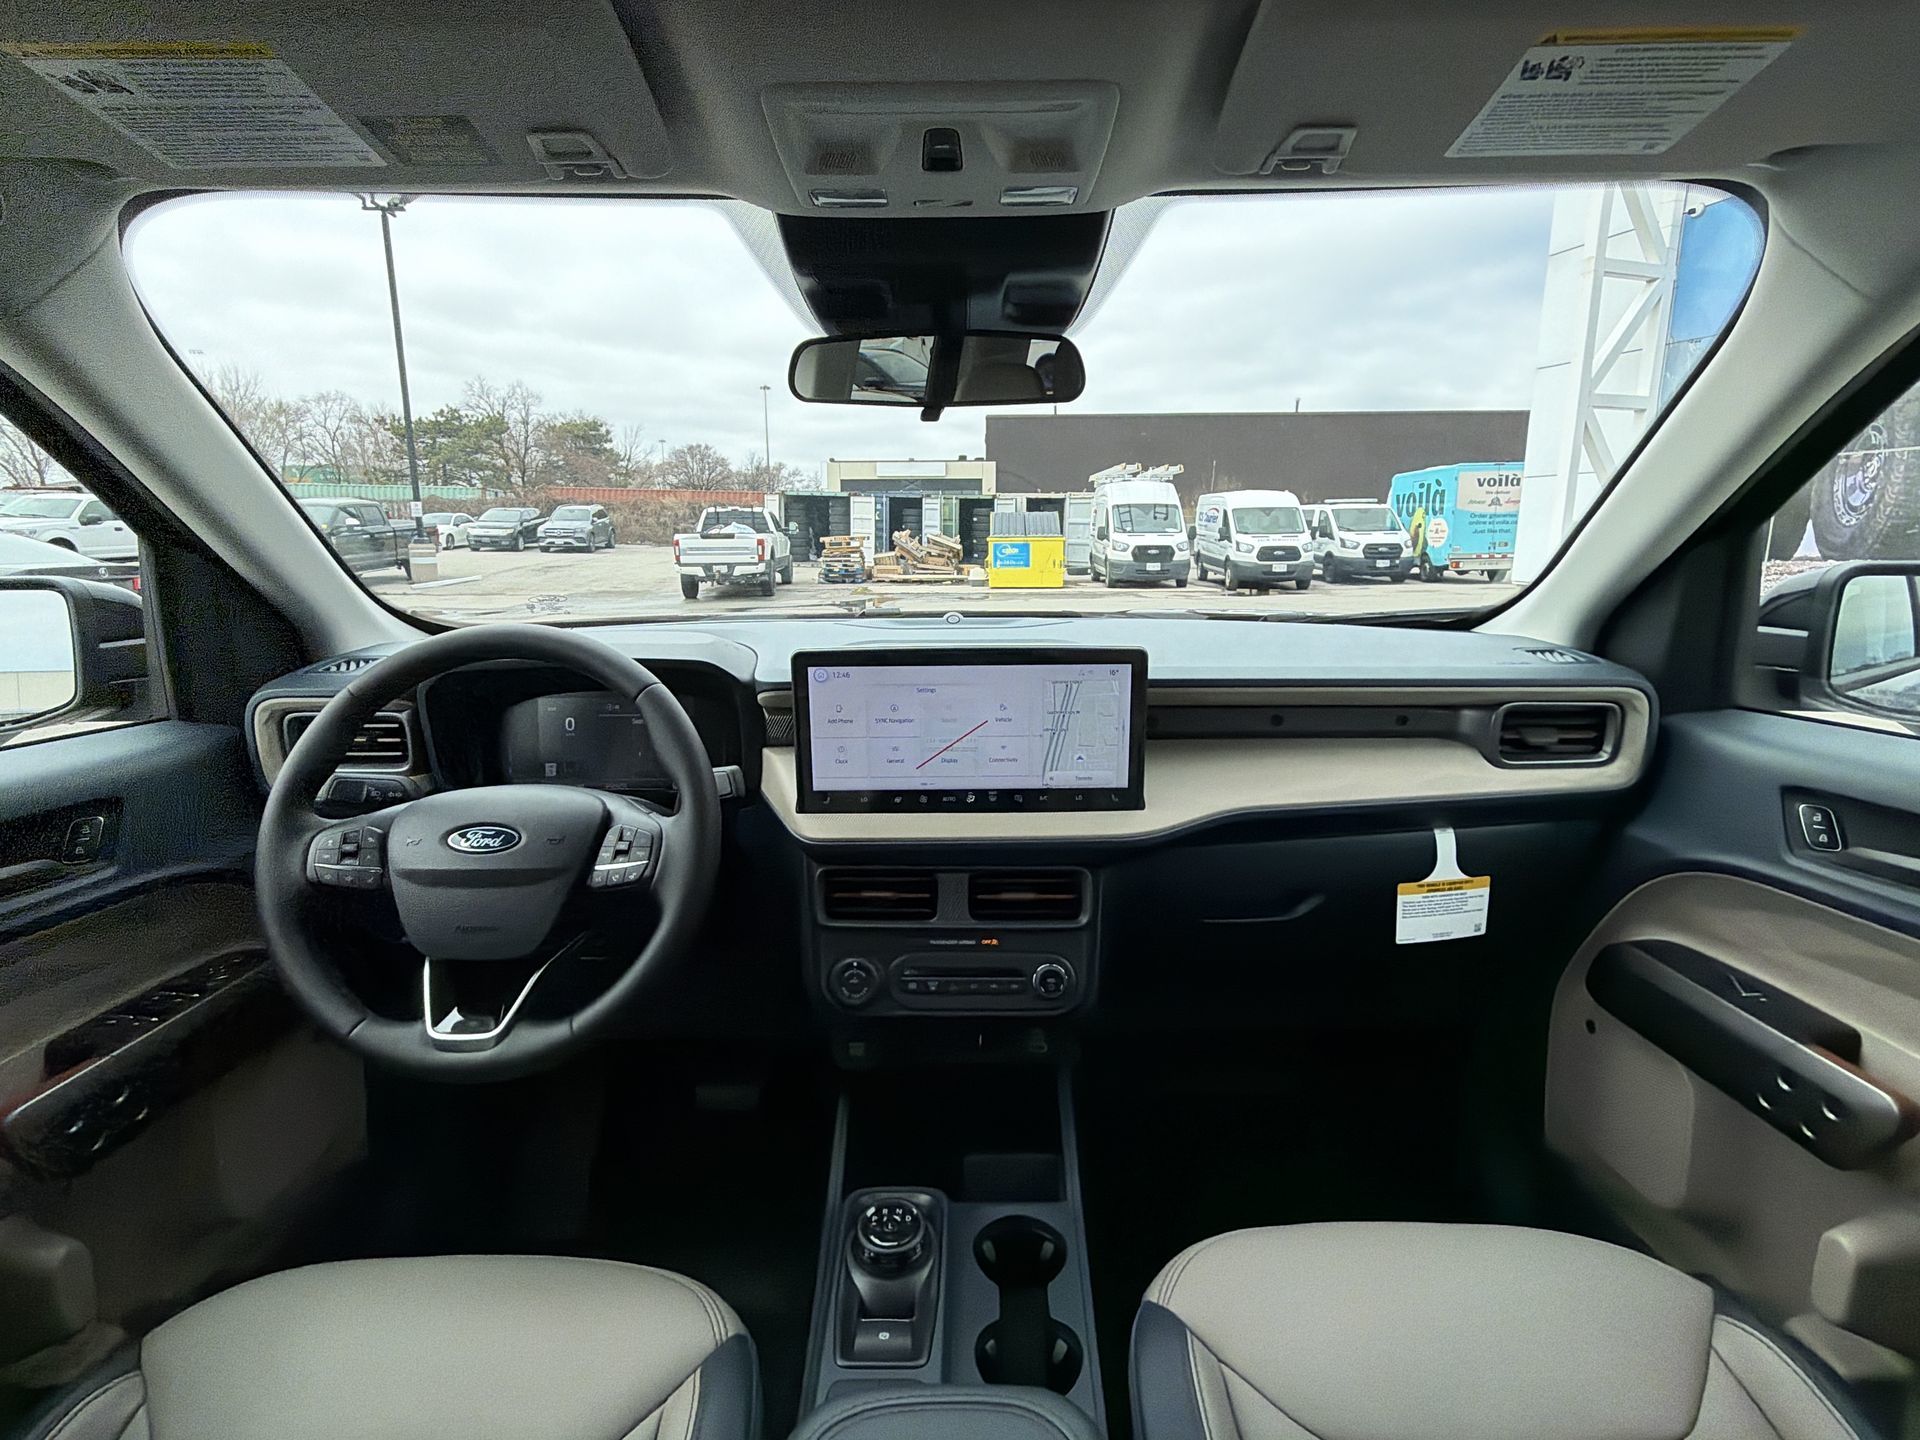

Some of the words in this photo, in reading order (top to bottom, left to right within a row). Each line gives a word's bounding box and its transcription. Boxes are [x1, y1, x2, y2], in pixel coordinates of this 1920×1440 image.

[1477, 473, 1521, 487] voilà
[1395, 478, 1446, 518] voilà
[832, 671, 851, 679] 12:46
[565, 717, 575, 731] 0
[460, 830, 506, 848] Ford
